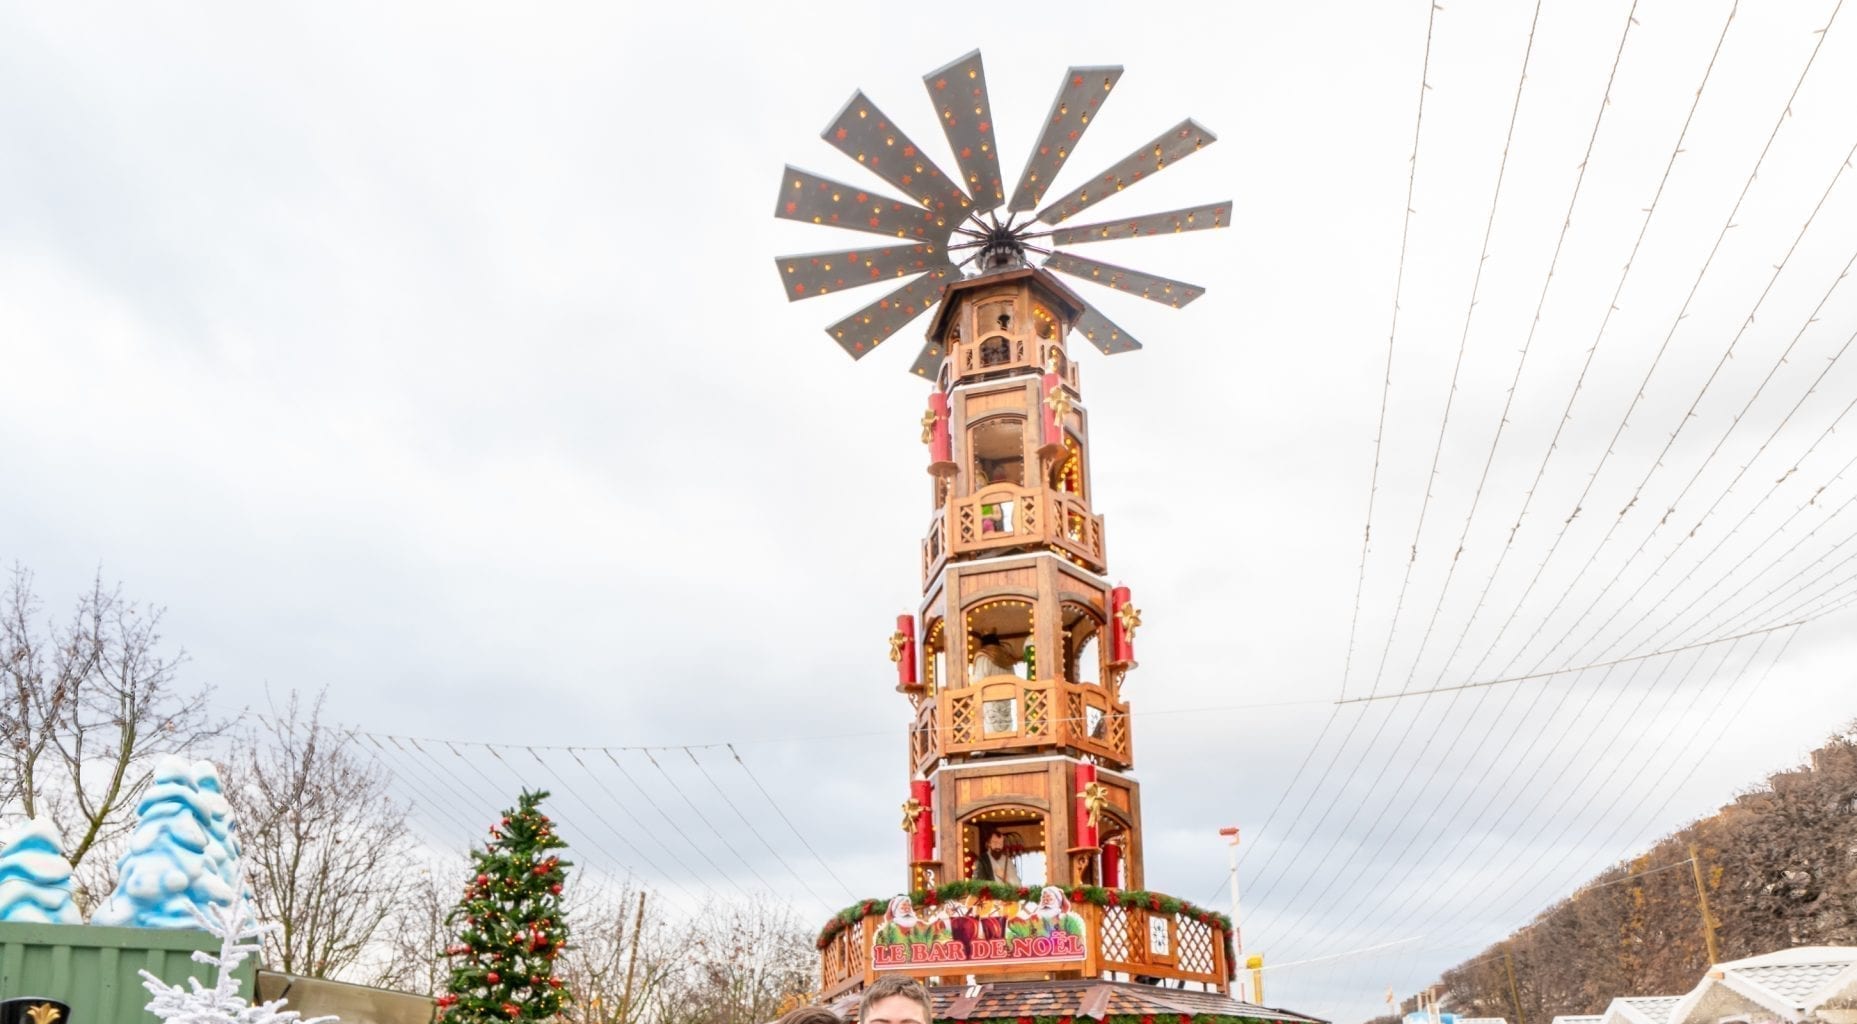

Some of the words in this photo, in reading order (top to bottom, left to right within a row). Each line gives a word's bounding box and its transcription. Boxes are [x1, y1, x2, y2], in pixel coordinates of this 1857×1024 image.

[874, 944, 906, 965] LE
[911, 941, 966, 962] BAR
[971, 939, 1008, 960] DE
[1013, 931, 1084, 957] NOËL
